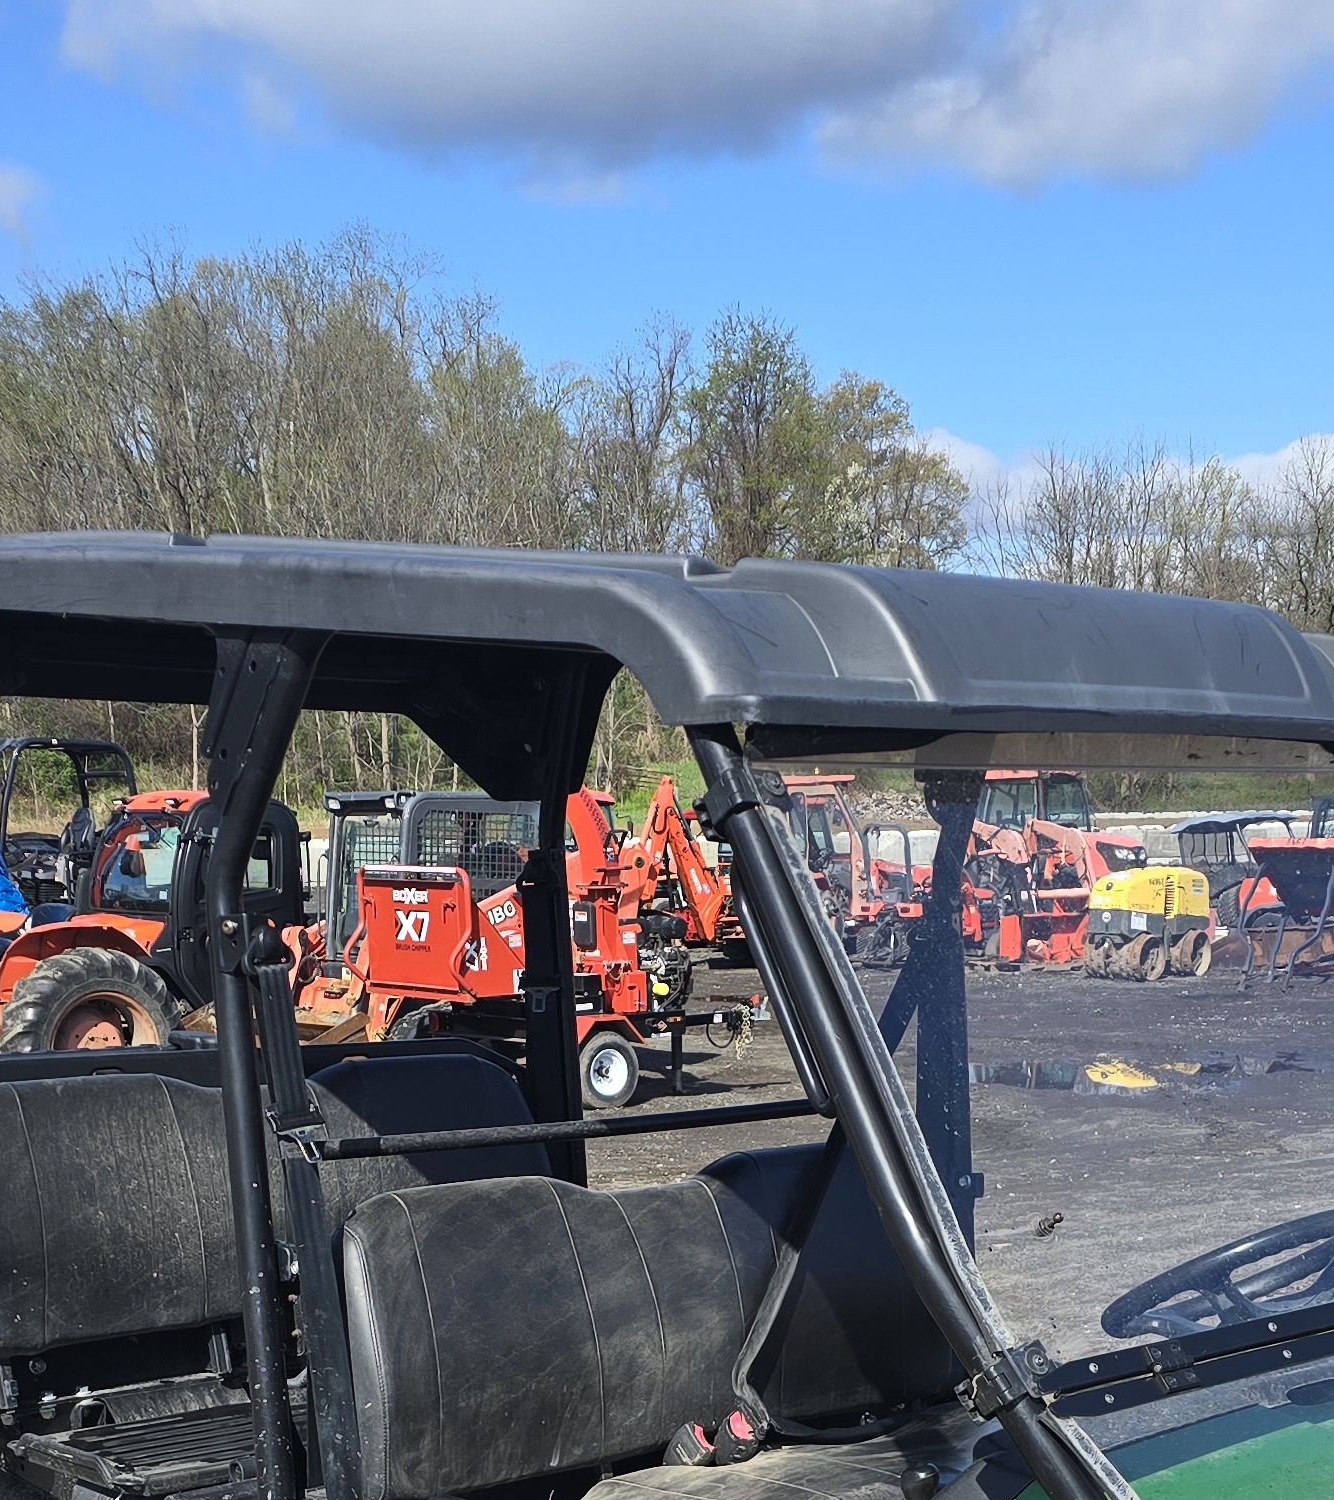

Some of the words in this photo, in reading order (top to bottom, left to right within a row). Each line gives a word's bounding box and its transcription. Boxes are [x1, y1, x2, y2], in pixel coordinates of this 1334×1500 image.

[392, 888, 429, 904] BOXER
[395, 910, 430, 942] X7
[395, 943, 410, 951] BRUSH
[411, 944, 431, 952] CHIPPER
